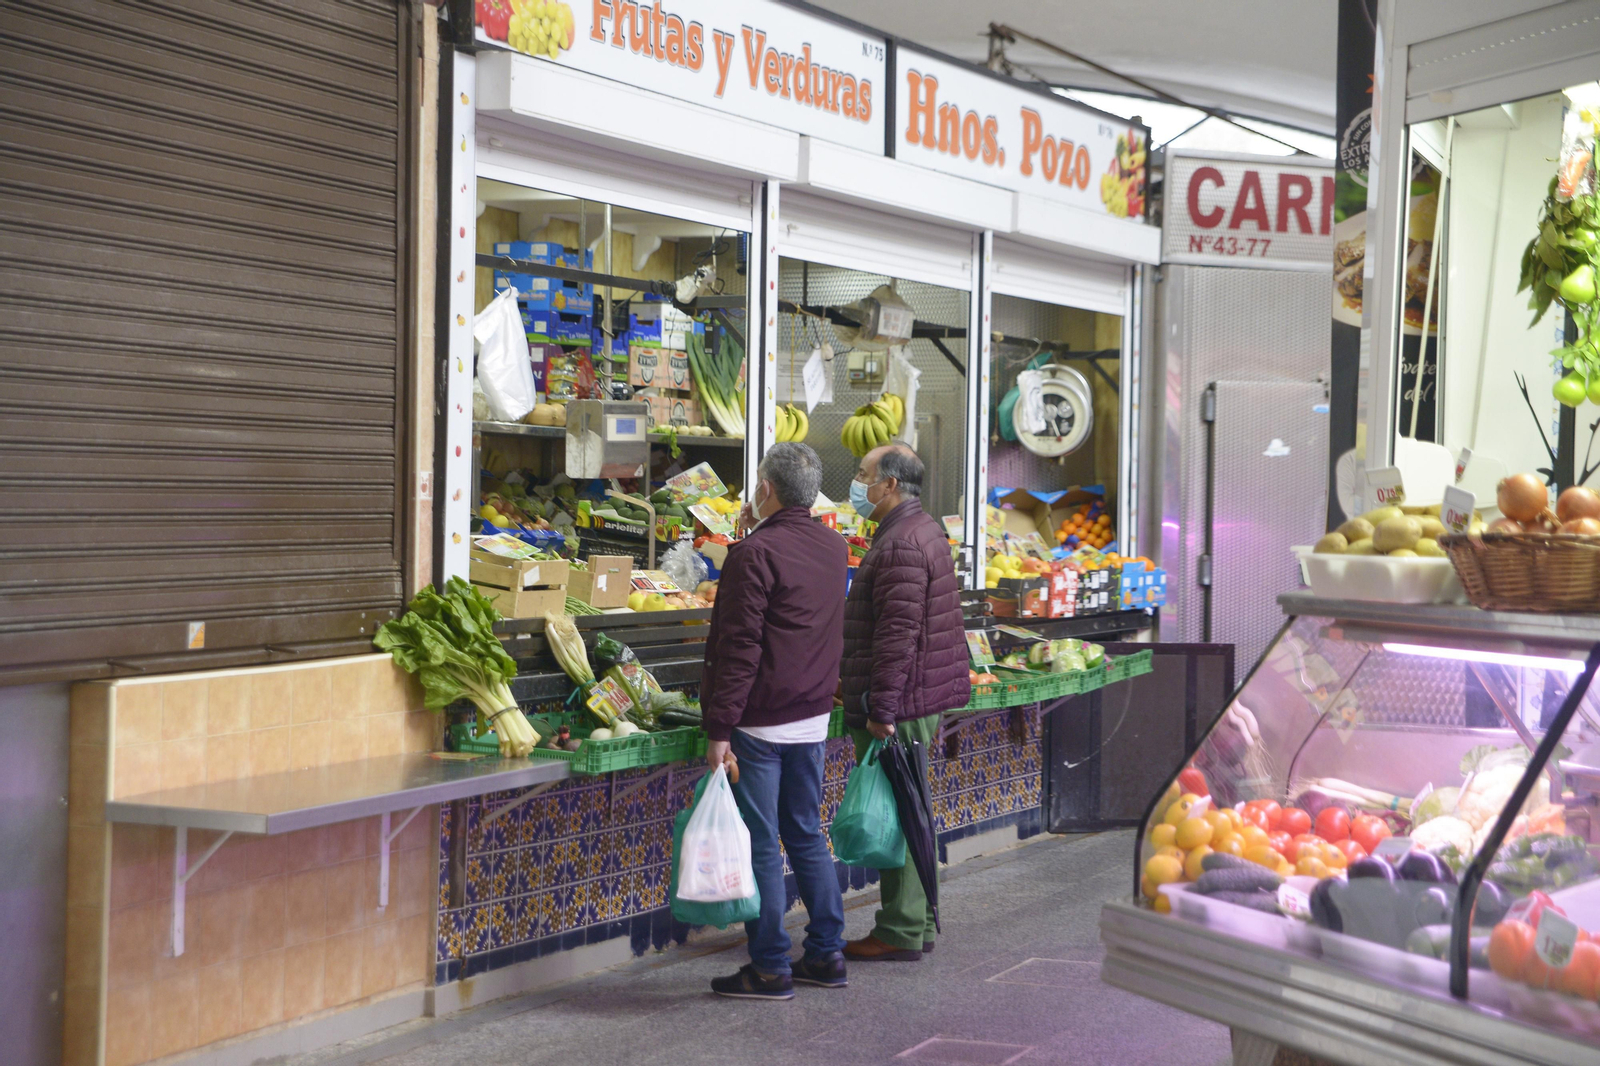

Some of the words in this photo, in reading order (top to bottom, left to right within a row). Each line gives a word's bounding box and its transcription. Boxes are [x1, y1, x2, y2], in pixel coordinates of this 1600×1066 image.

[590, 0, 704, 72] Frutas
[712, 28, 735, 99] y
[742, 24, 873, 123] Verduras
[905, 69, 1006, 168] Hnos.
[1020, 106, 1091, 191] Pozo
[1341, 143, 1370, 161] EXTR
